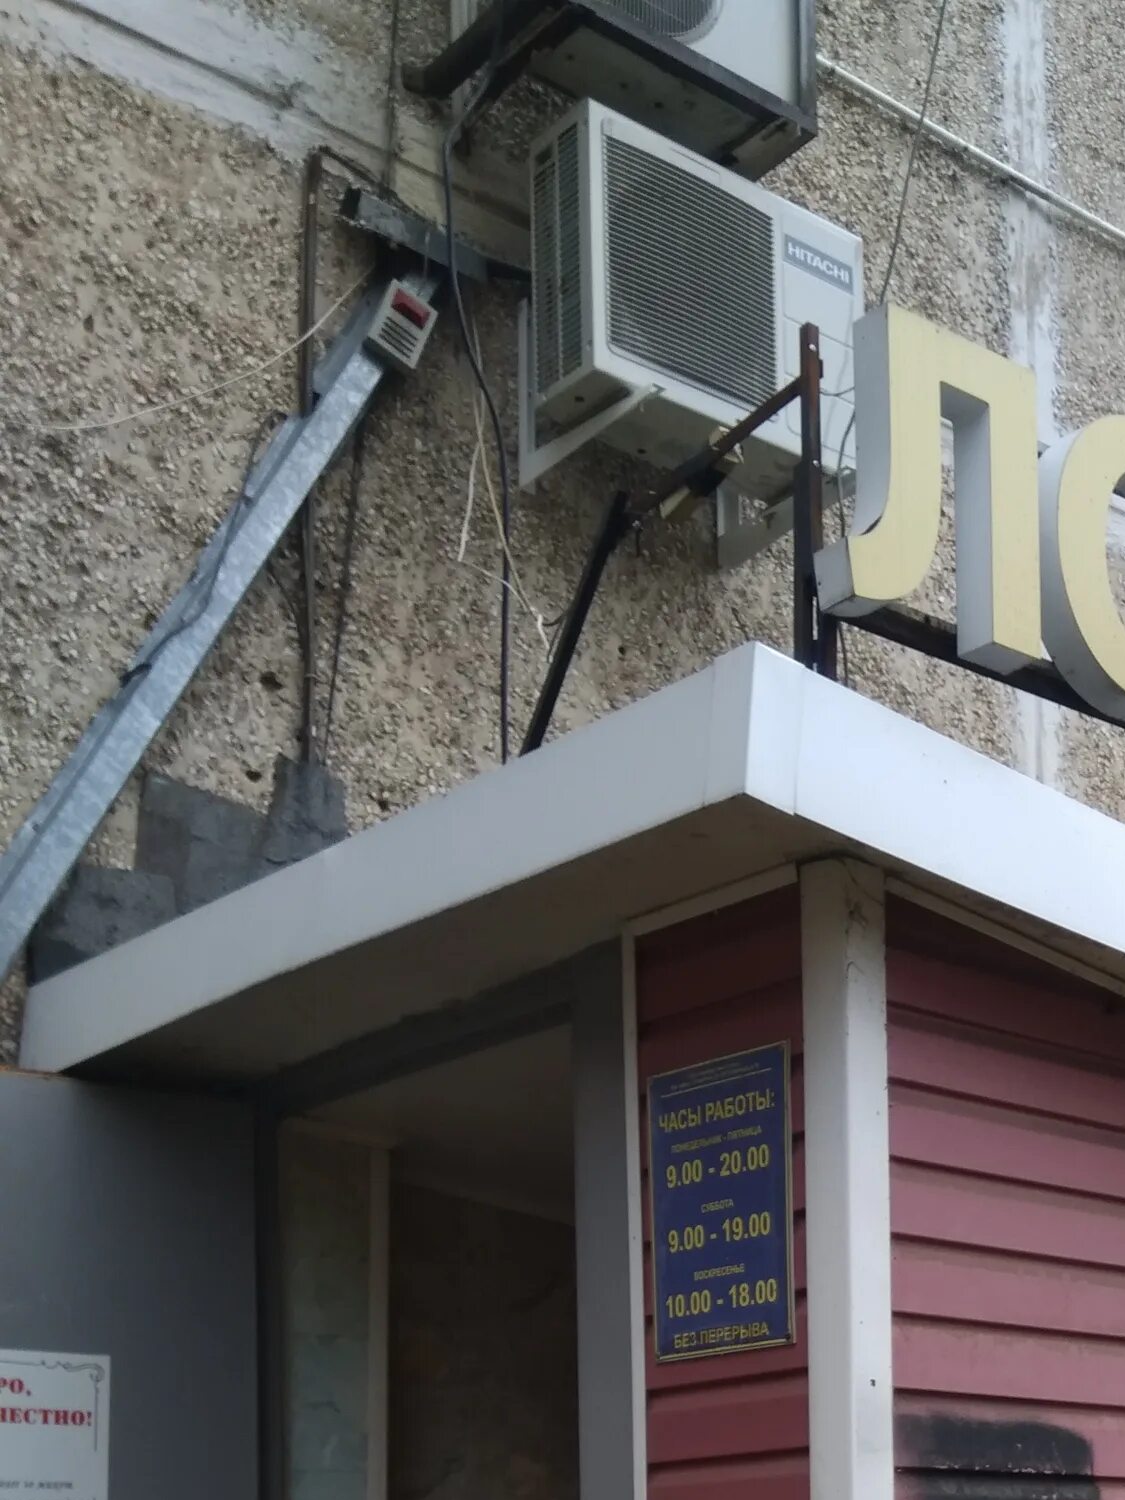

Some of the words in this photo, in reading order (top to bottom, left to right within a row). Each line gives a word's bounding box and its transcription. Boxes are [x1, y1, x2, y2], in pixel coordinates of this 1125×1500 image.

[787, 242, 850, 284] HITACHI
[659, 1105, 702, 1133] ЧАСЫ
[705, 1088, 776, 1123] РАБОТЫ:
[666, 1159, 702, 1188] 9.00
[719, 1143, 769, 1176] 20.00
[701, 1198, 734, 1213] СУББОТА
[668, 1224, 705, 1253] 9.00
[722, 1211, 771, 1242] 19.00
[665, 1289, 711, 1318] 10.00
[728, 1278, 777, 1308] 18.00
[674, 1332, 697, 1348] БЕЗ
[699, 1322, 769, 1345] ПЕРЕРЫВА
[0, 1407, 92, 1427] ЕСТНО!
